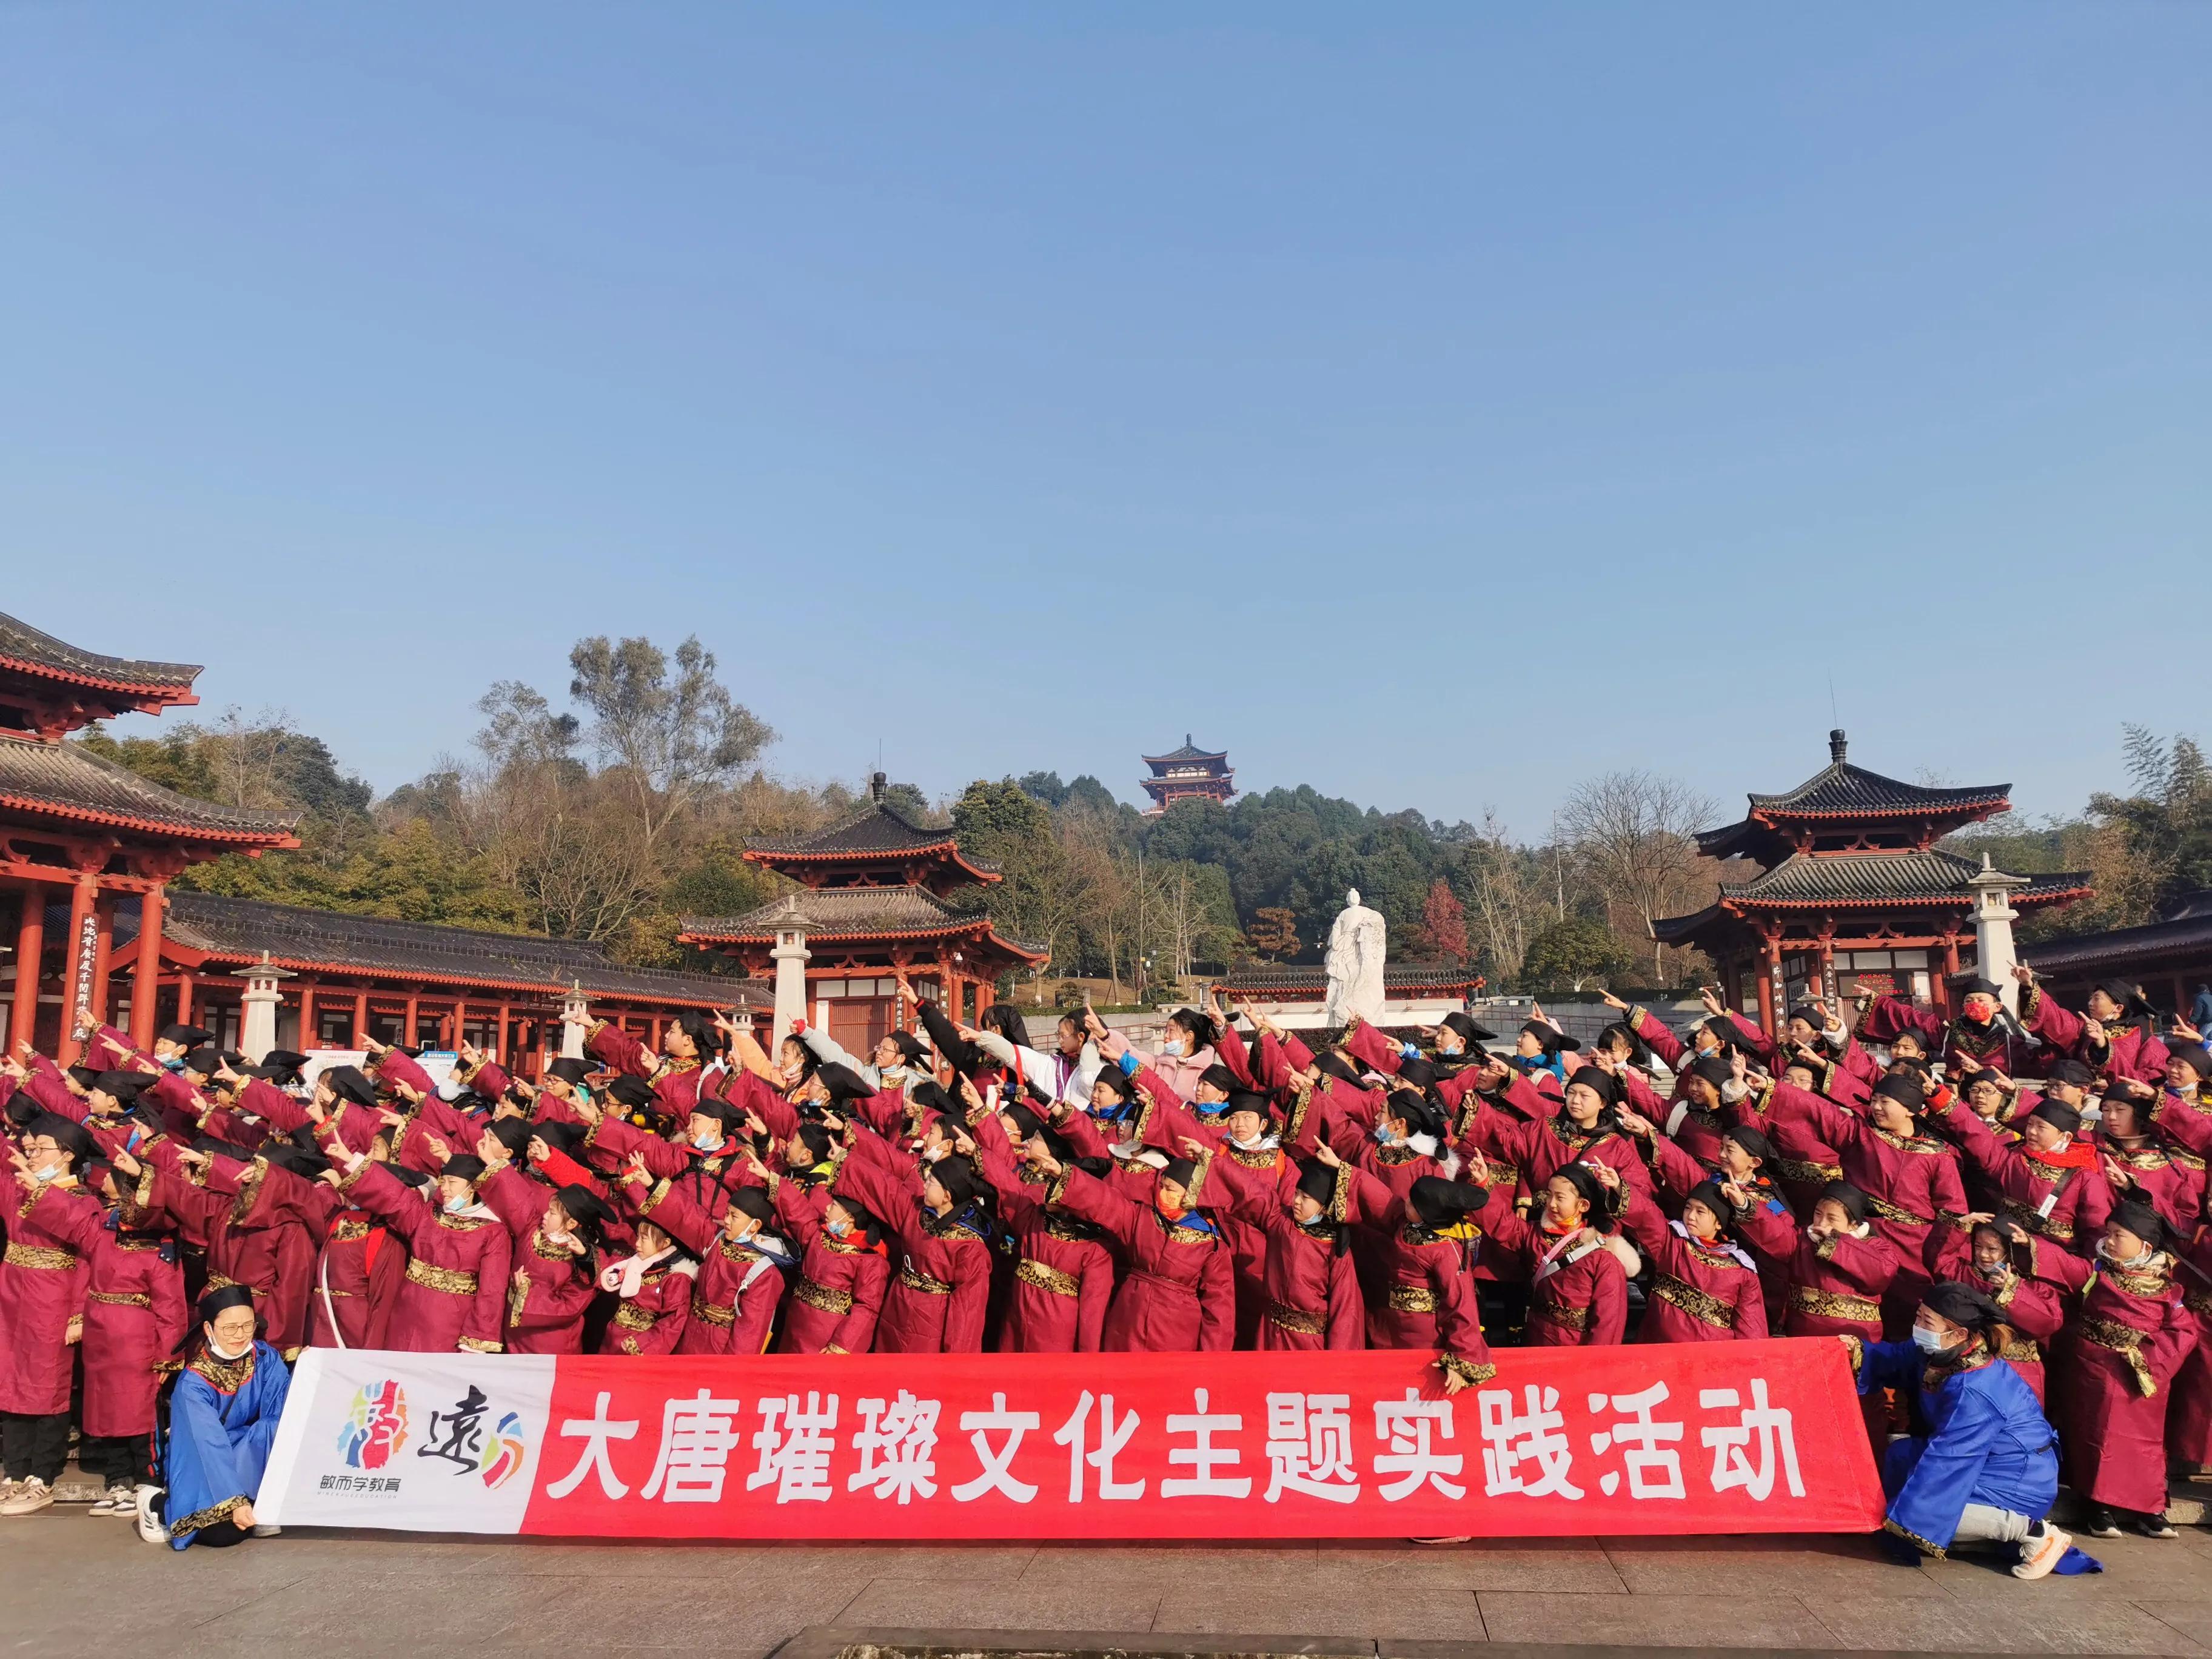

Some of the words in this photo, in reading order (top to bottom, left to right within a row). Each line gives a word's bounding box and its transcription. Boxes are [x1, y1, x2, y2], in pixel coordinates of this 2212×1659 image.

[546, 1378, 1806, 1504] 大唐璀璨文化主题实践活动
[320, 1474, 402, 1492] 敏而学教育
